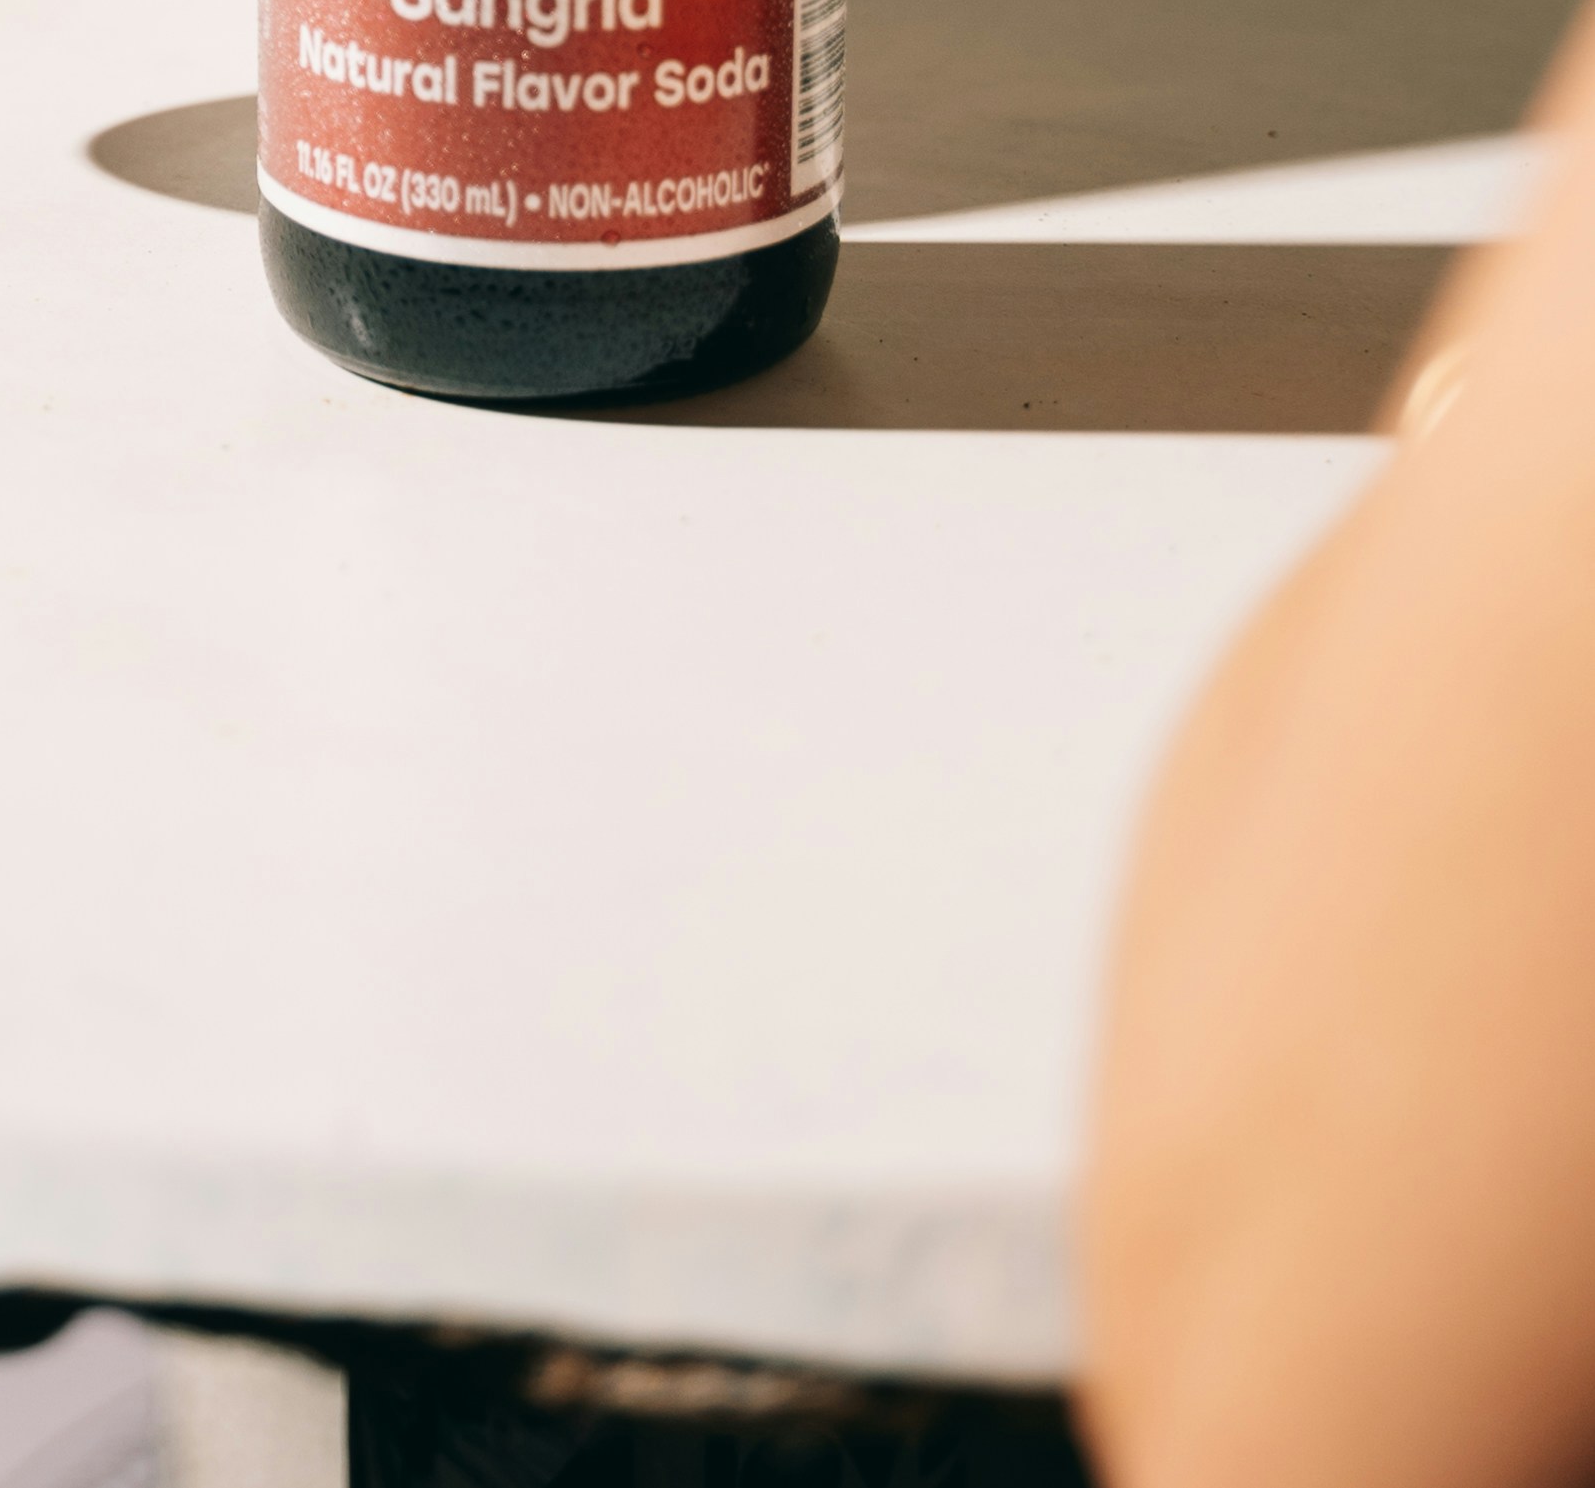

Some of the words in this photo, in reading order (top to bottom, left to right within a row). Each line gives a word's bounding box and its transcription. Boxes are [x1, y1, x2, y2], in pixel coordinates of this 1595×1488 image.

[298, 24, 457, 106] Natural
[472, 59, 639, 112] Flavor
[654, 47, 771, 107] Soda
[296, 140, 333, 186] 11.16
[335, 153, 360, 194] FL
[363, 162, 397, 203] OZ
[401, 169, 460, 217] (330
[464, 178, 518, 227] mL)
